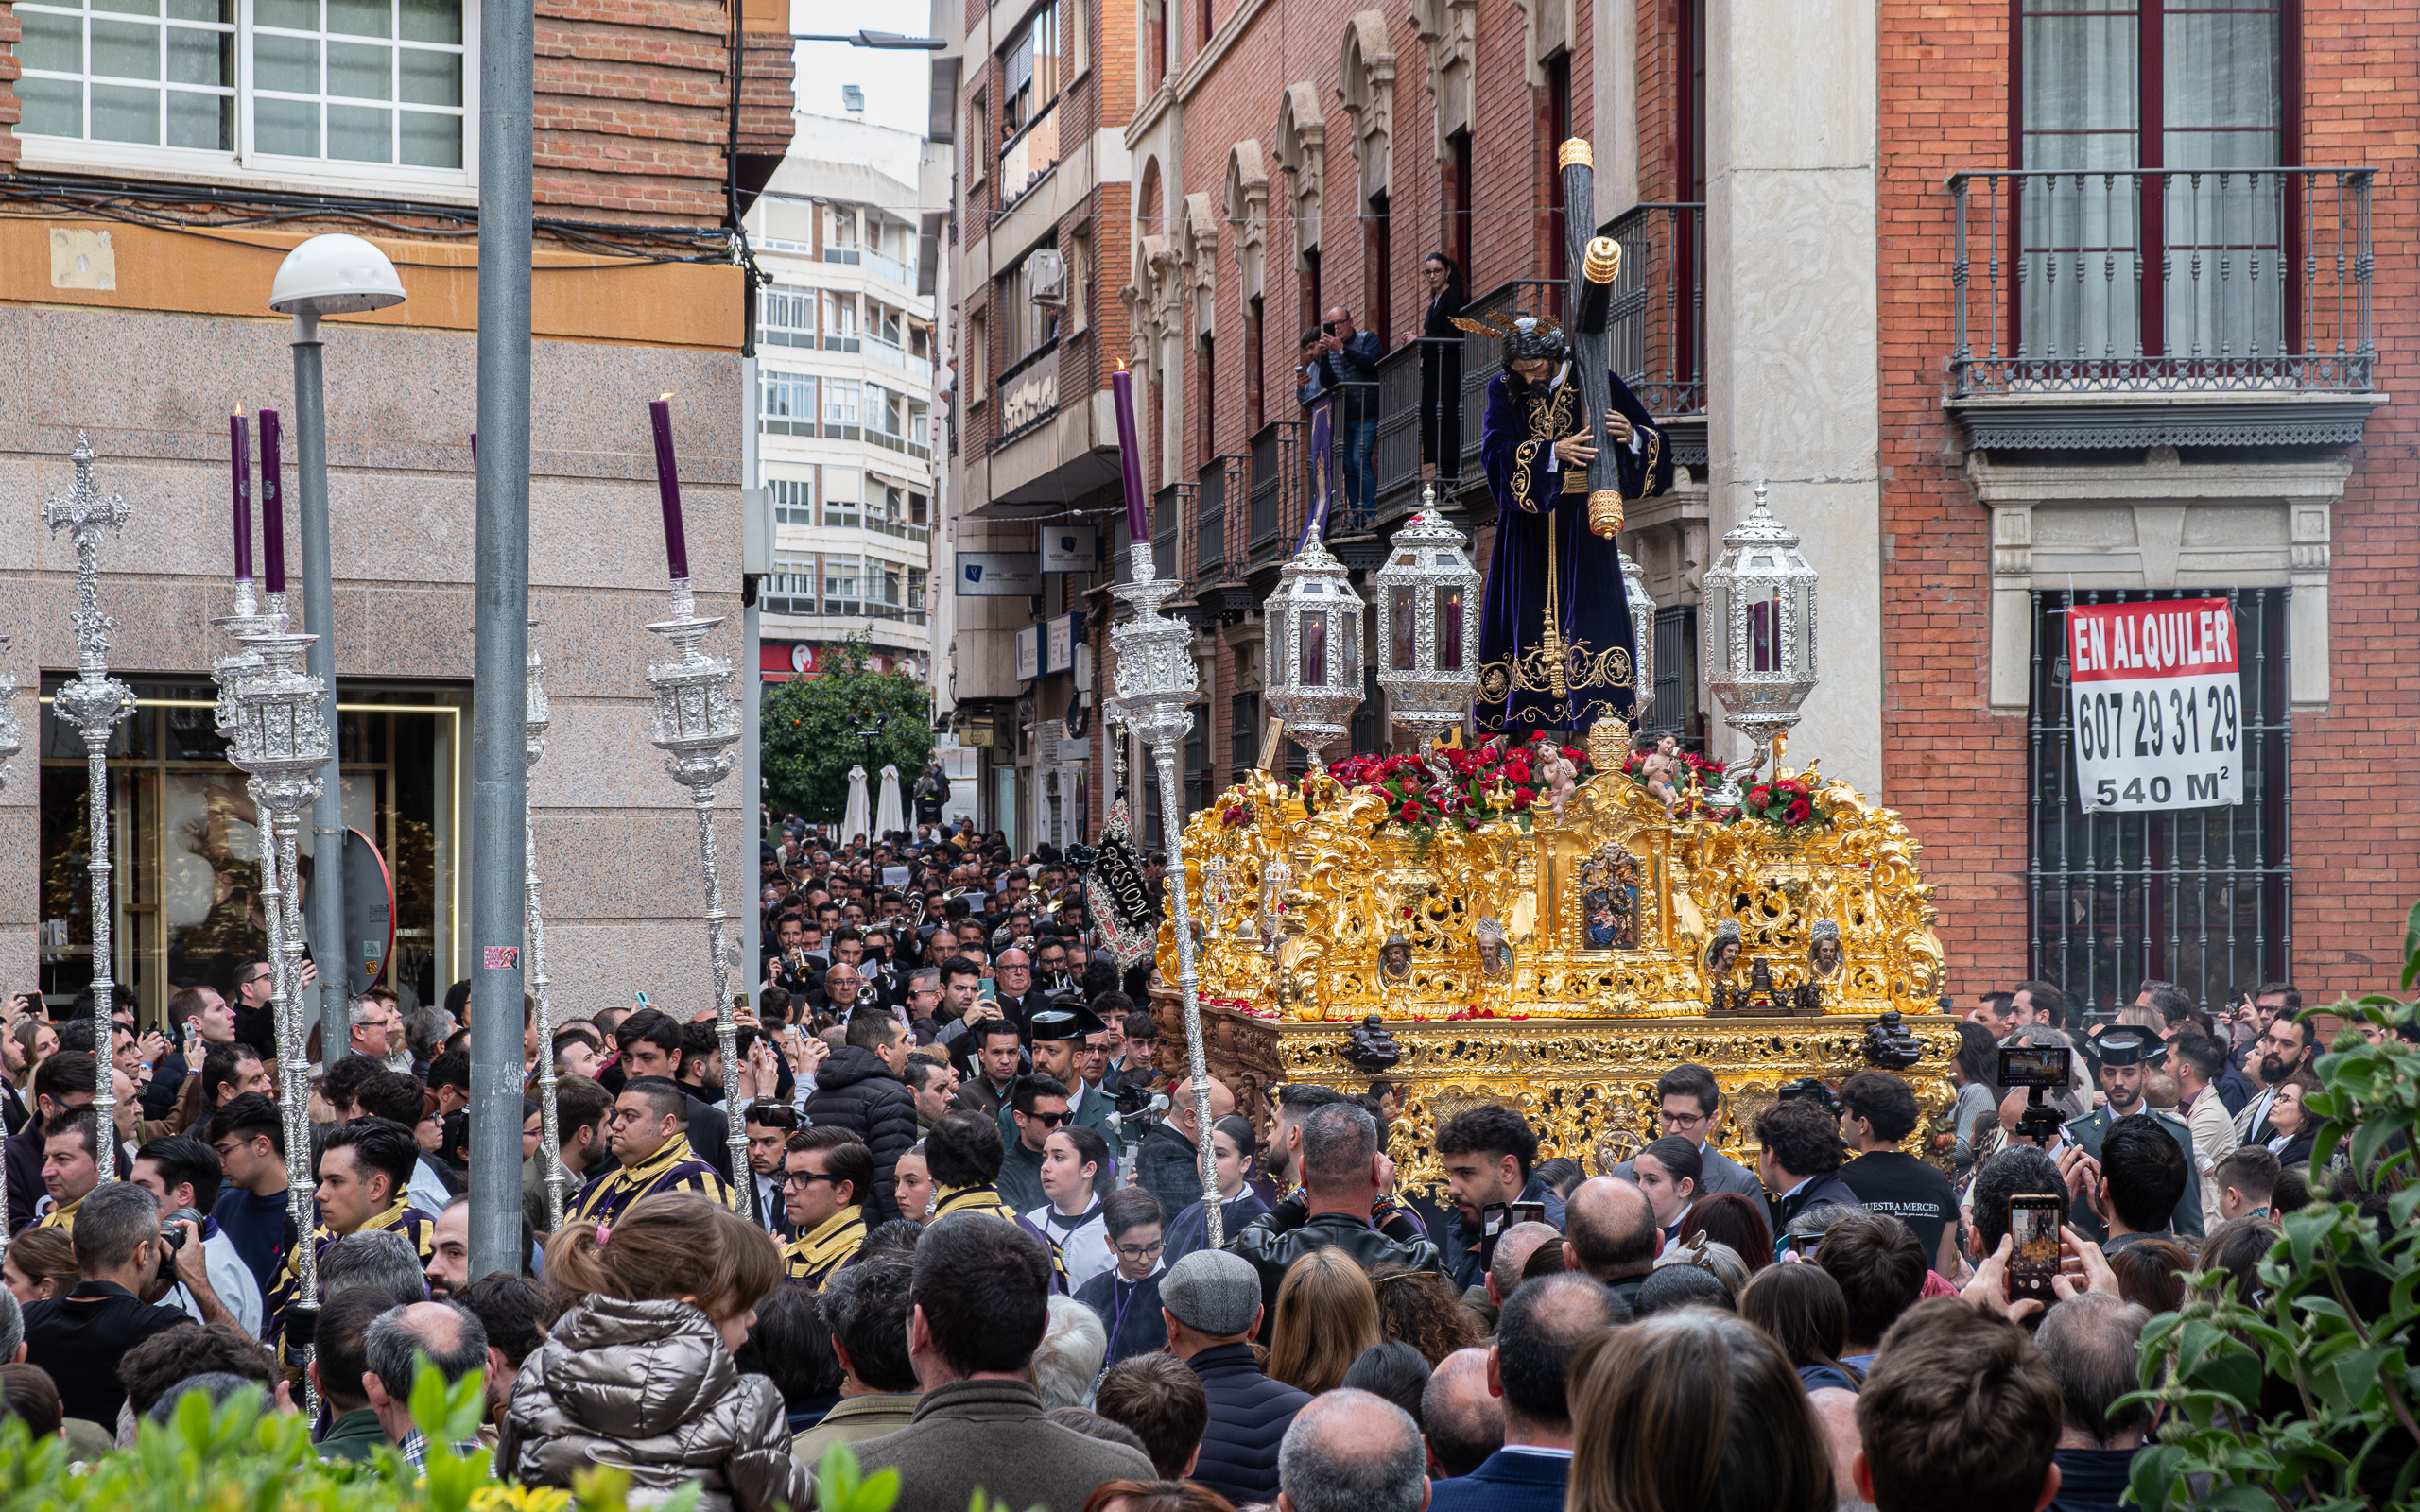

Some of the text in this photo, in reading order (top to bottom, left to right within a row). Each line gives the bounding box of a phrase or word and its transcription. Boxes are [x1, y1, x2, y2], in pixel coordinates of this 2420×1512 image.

[2074, 610, 2232, 672] EN ALQUILER
[2080, 684, 2238, 761] 607 29 31 29
[2097, 775, 2171, 806] 540
[1098, 846, 1151, 921] PASION
[1903, 1202, 1940, 1212] MERCED
